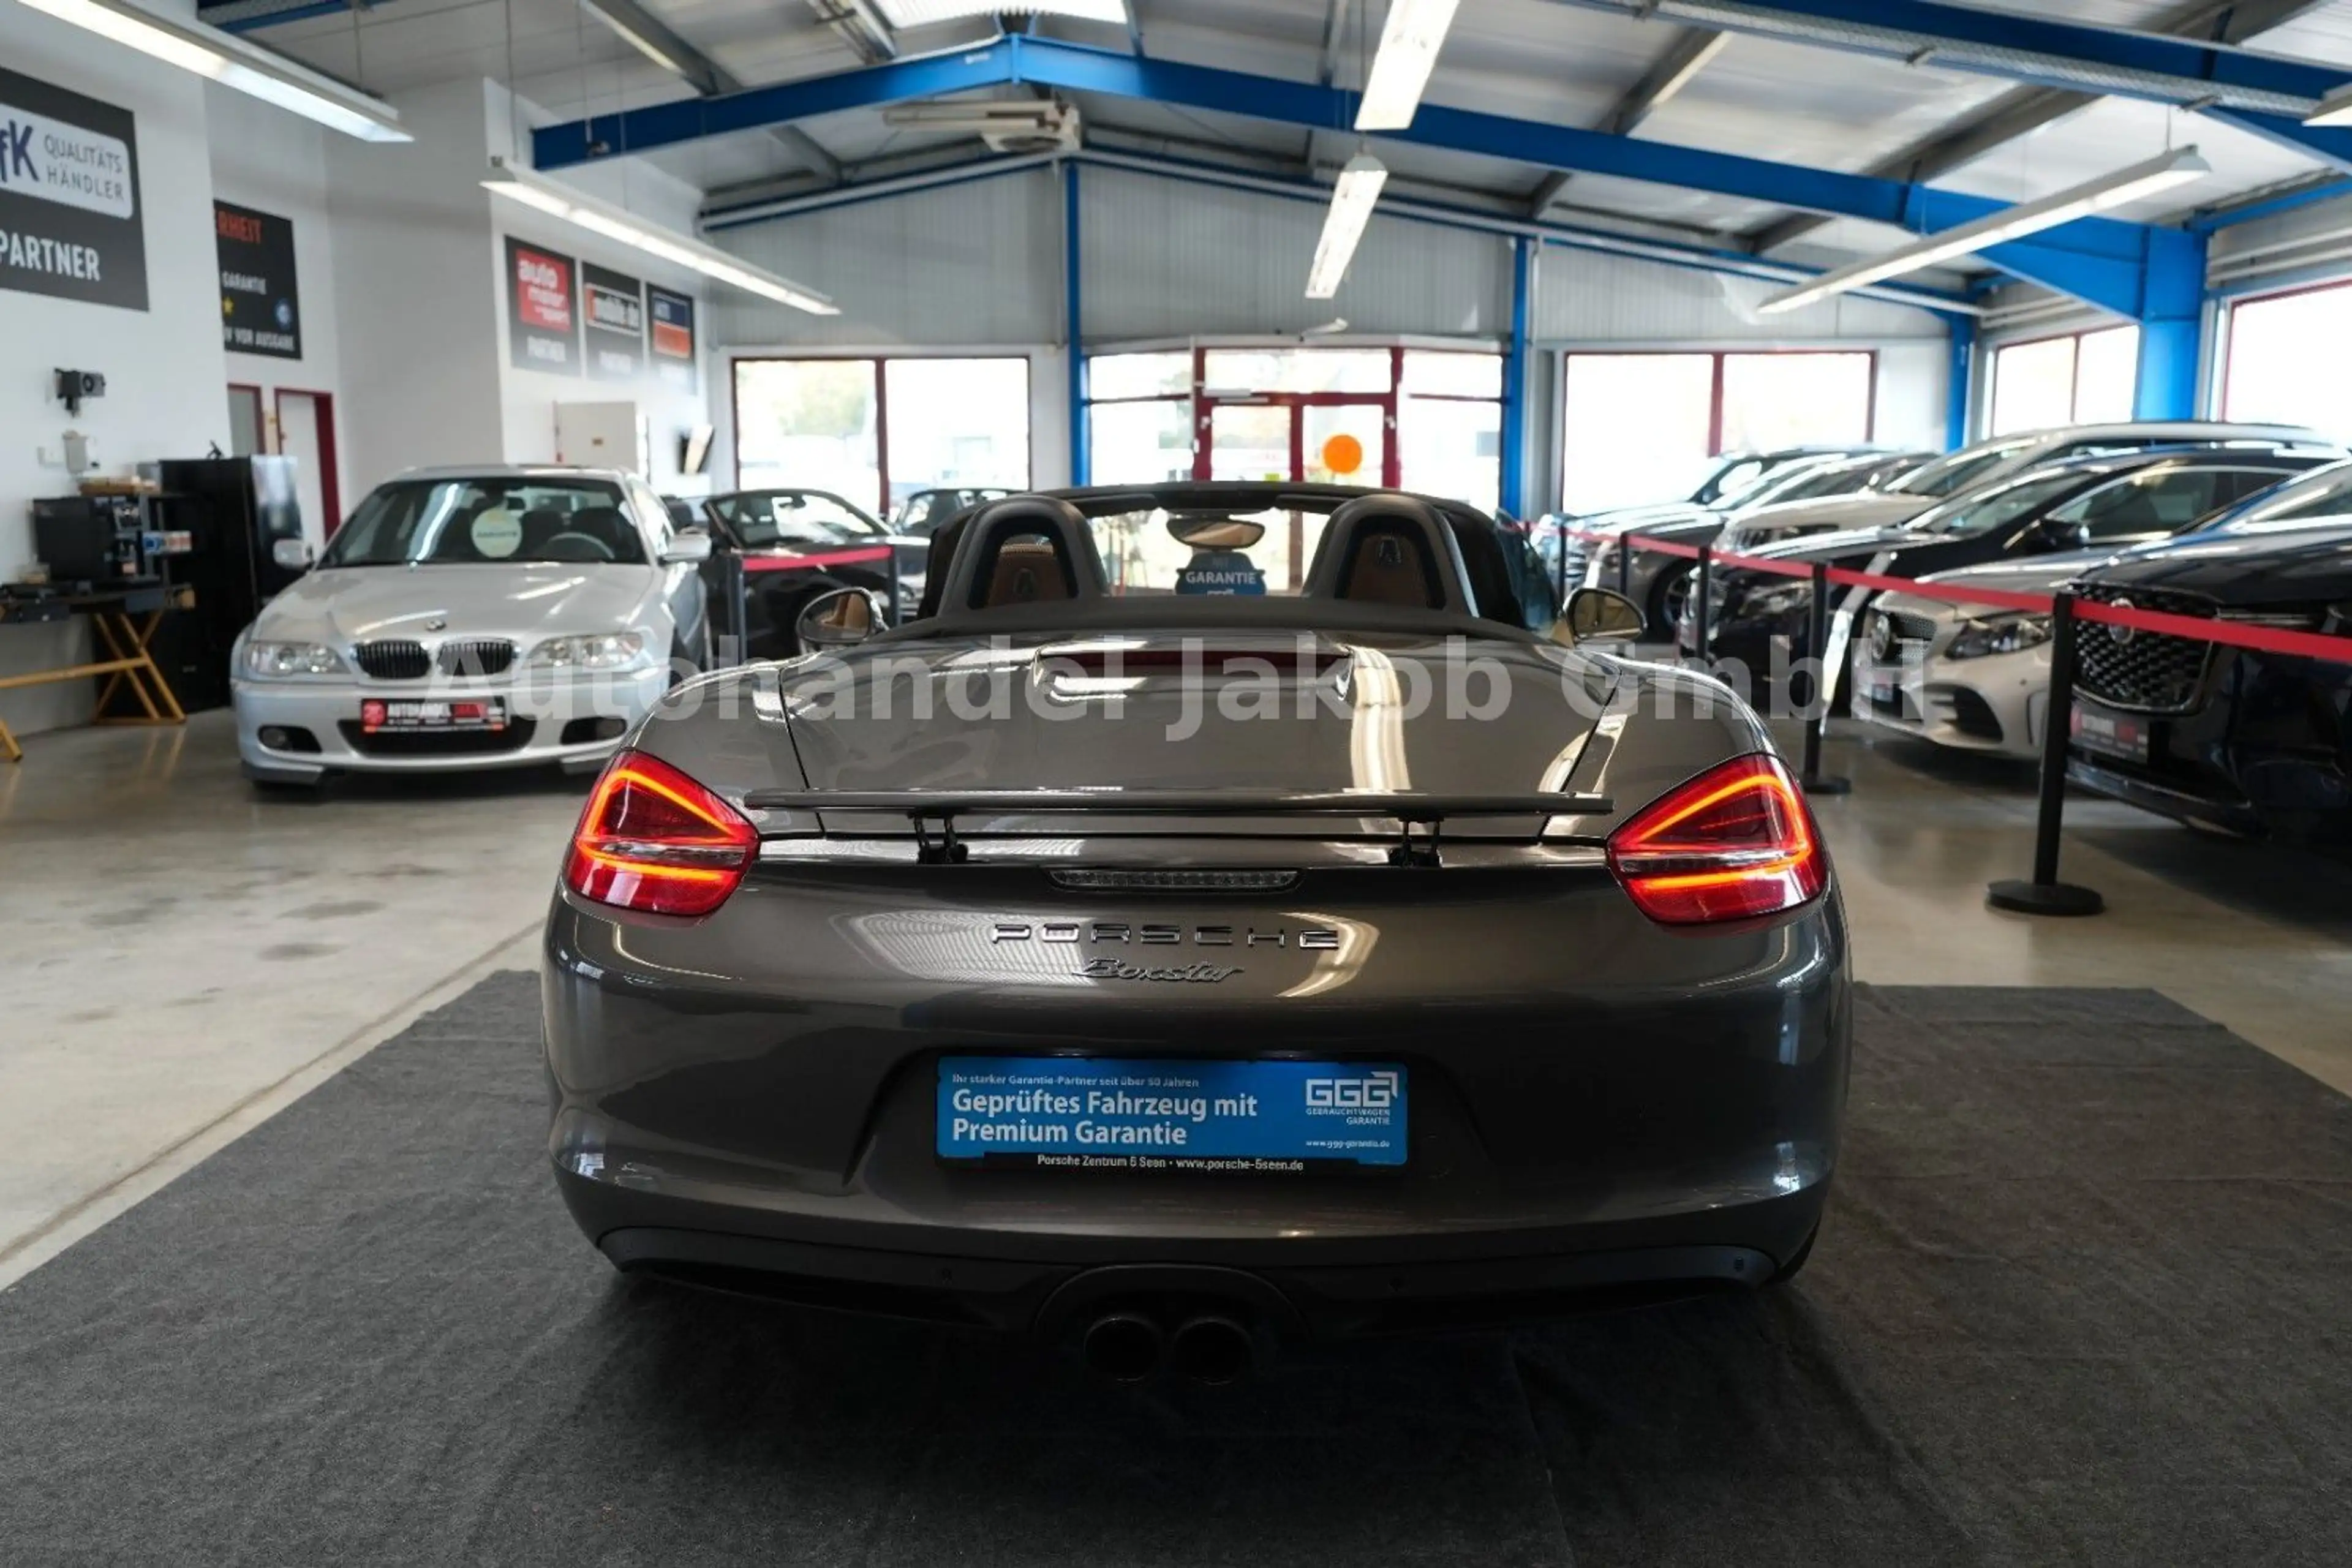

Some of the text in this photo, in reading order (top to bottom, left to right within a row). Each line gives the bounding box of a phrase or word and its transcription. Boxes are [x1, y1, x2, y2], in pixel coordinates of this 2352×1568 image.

[44, 134, 123, 174] QUALITÄTS
[47, 163, 124, 200] HÄNDLER
[214, 209, 262, 244] RHEIT
[1185, 571, 1257, 585] GARANTIE
[992, 923, 1340, 949] PORSCHE
[1072, 957, 1245, 982] Boxster
[952, 1074, 1199, 1088] Ihr starker Garantie-Partner seit über 50 Jahren
[1306, 1078, 1391, 1107] GGG
[952, 1088, 1258, 1122] Geprüftes Fahrzeug mit
[1305, 1107, 1390, 1116] GEBRAUCHTWAGEN
[952, 1118, 1188, 1145] Premium Garantie
[1346, 1116, 1390, 1125] GARANTIE
[1037, 1153, 1081, 1166] Porsche
[1082, 1155, 1127, 1167] Zentrum
[1139, 1156, 1166, 1168] Seen
[1176, 1158, 1304, 1171] www.porsche-5seen.de
